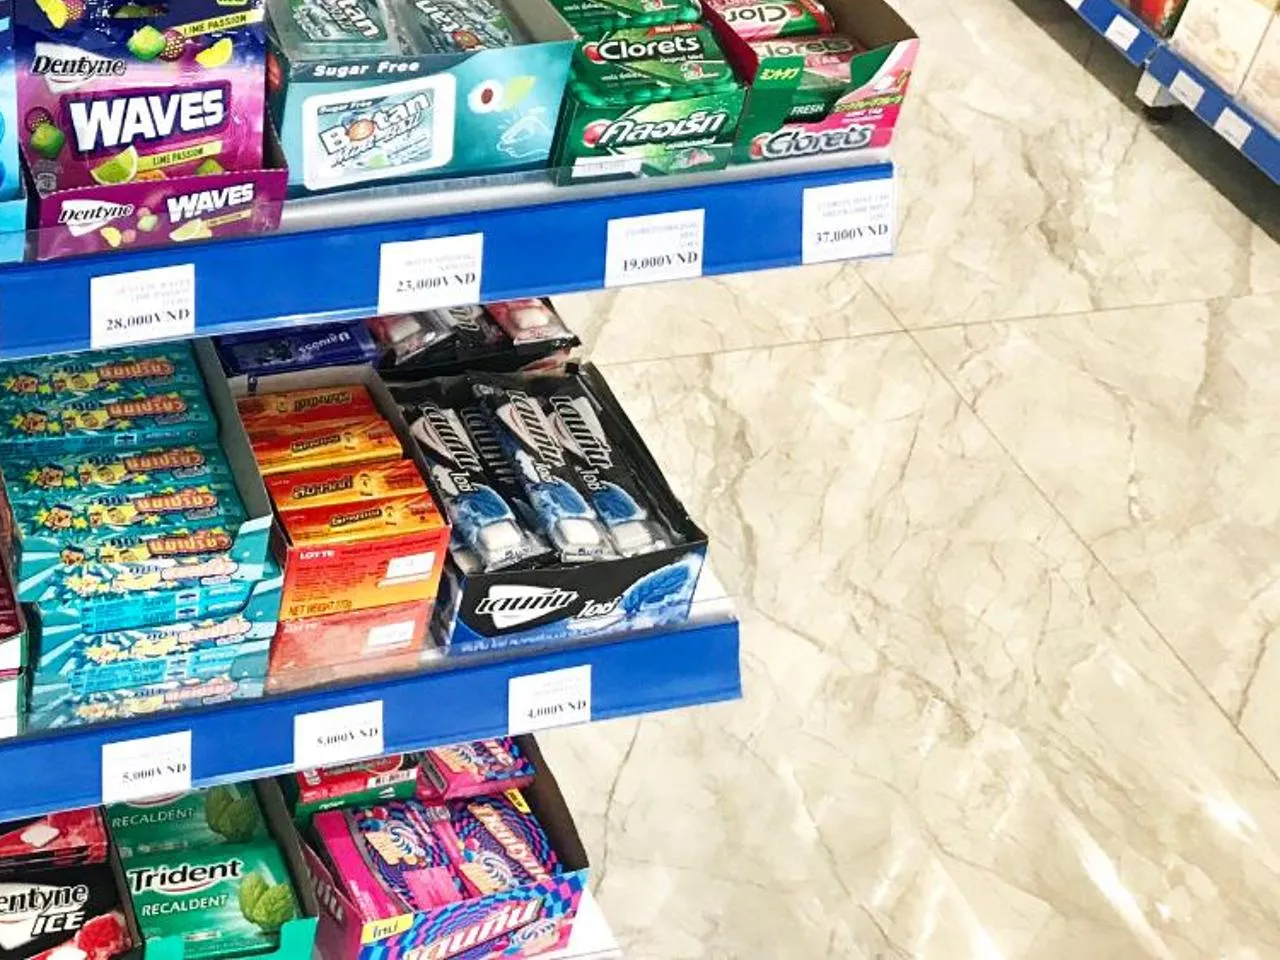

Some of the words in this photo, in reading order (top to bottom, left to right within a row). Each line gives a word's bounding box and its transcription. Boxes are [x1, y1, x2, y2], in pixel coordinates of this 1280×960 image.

[184, 22, 204, 35] LIME
[207, 14, 248, 31] PASSION
[600, 36, 700, 60] Clorets
[32, 54, 127, 79] Dentyne
[314, 65, 369, 78] Sugar
[377, 60, 420, 74] Free
[69, 89, 225, 152] WAVES
[791, 102, 825, 116] FRESH
[765, 126, 873, 155] Clorets
[58, 200, 134, 224] Dentyne
[168, 183, 254, 222] WAVES
[623, 251, 699, 272] 19,000VND
[106, 308, 191, 332] 28,000VND
[299, 549, 335, 560] LOTTE
[112, 808, 195, 828] RECALDENT
[128, 858, 243, 894] Trident
[142, 894, 229, 916] RECALDENT
[31, 913, 86, 937] ICE
